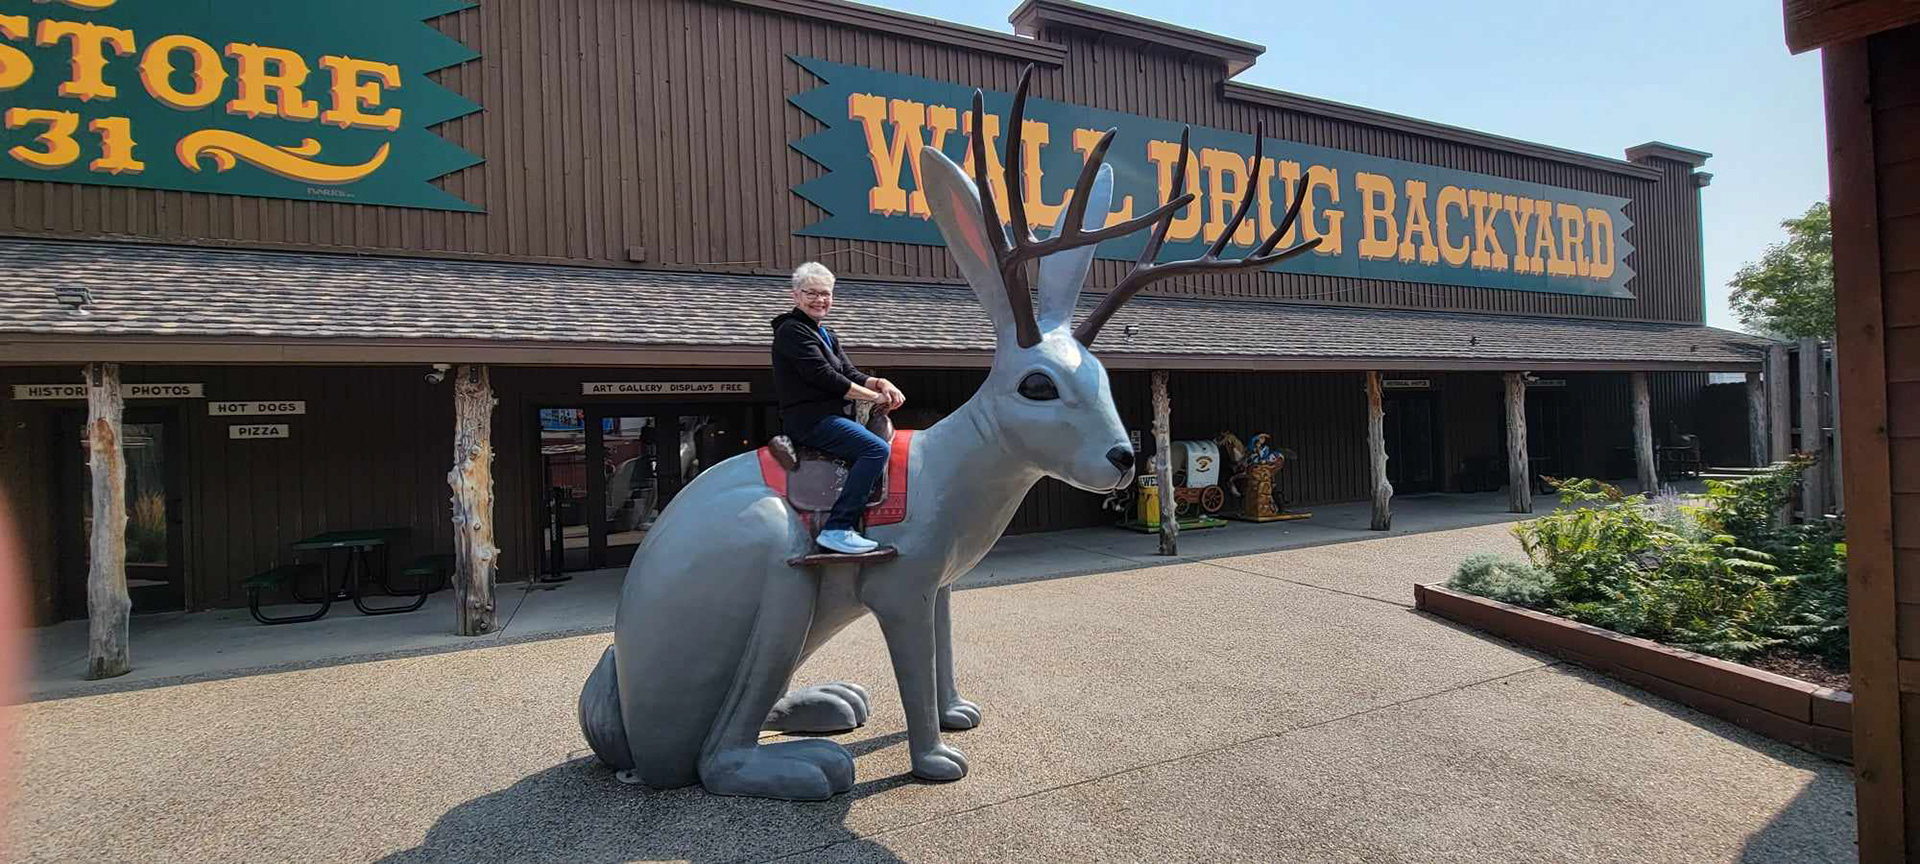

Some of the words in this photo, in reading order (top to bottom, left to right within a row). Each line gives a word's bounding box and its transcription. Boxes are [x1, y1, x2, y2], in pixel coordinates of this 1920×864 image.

[848, 93, 1135, 229] WALL
[1146, 139, 1345, 256] DRUG
[1355, 171, 1615, 280] BACKYARD
[132, 385, 191, 396] PHOTOS
[592, 384, 614, 392] ART
[618, 383, 663, 392] GALLERY
[670, 383, 714, 392] DISPLAYS
[720, 383, 743, 391] FREE
[218, 404, 249, 412] HOT
[258, 403, 296, 412] DOGS
[239, 427, 279, 436] PIZZA
